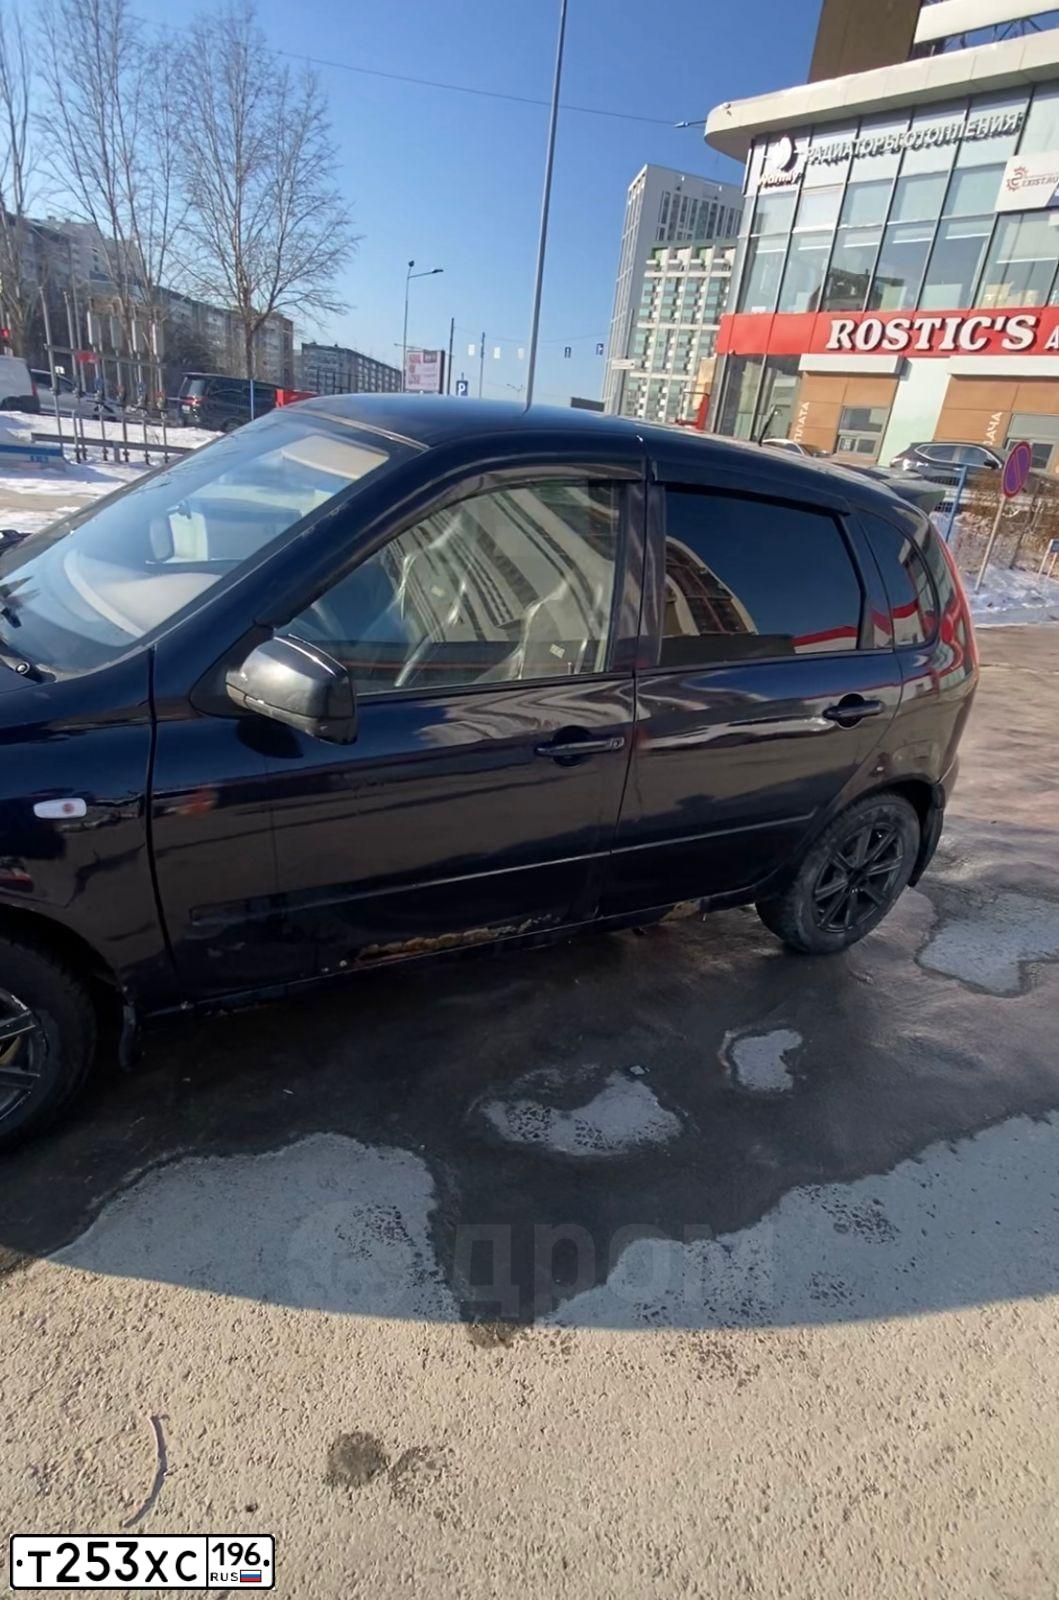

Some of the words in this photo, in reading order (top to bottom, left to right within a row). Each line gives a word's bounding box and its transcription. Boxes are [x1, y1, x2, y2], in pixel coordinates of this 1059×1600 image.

[805, 131, 902, 163] РАДИАТОРЫ
[902, 111, 1019, 148] ОТОПЛЕНИЯ
[825, 315, 1037, 351] ROSTIC'S
[793, 401, 810, 442] ПЛАТА
